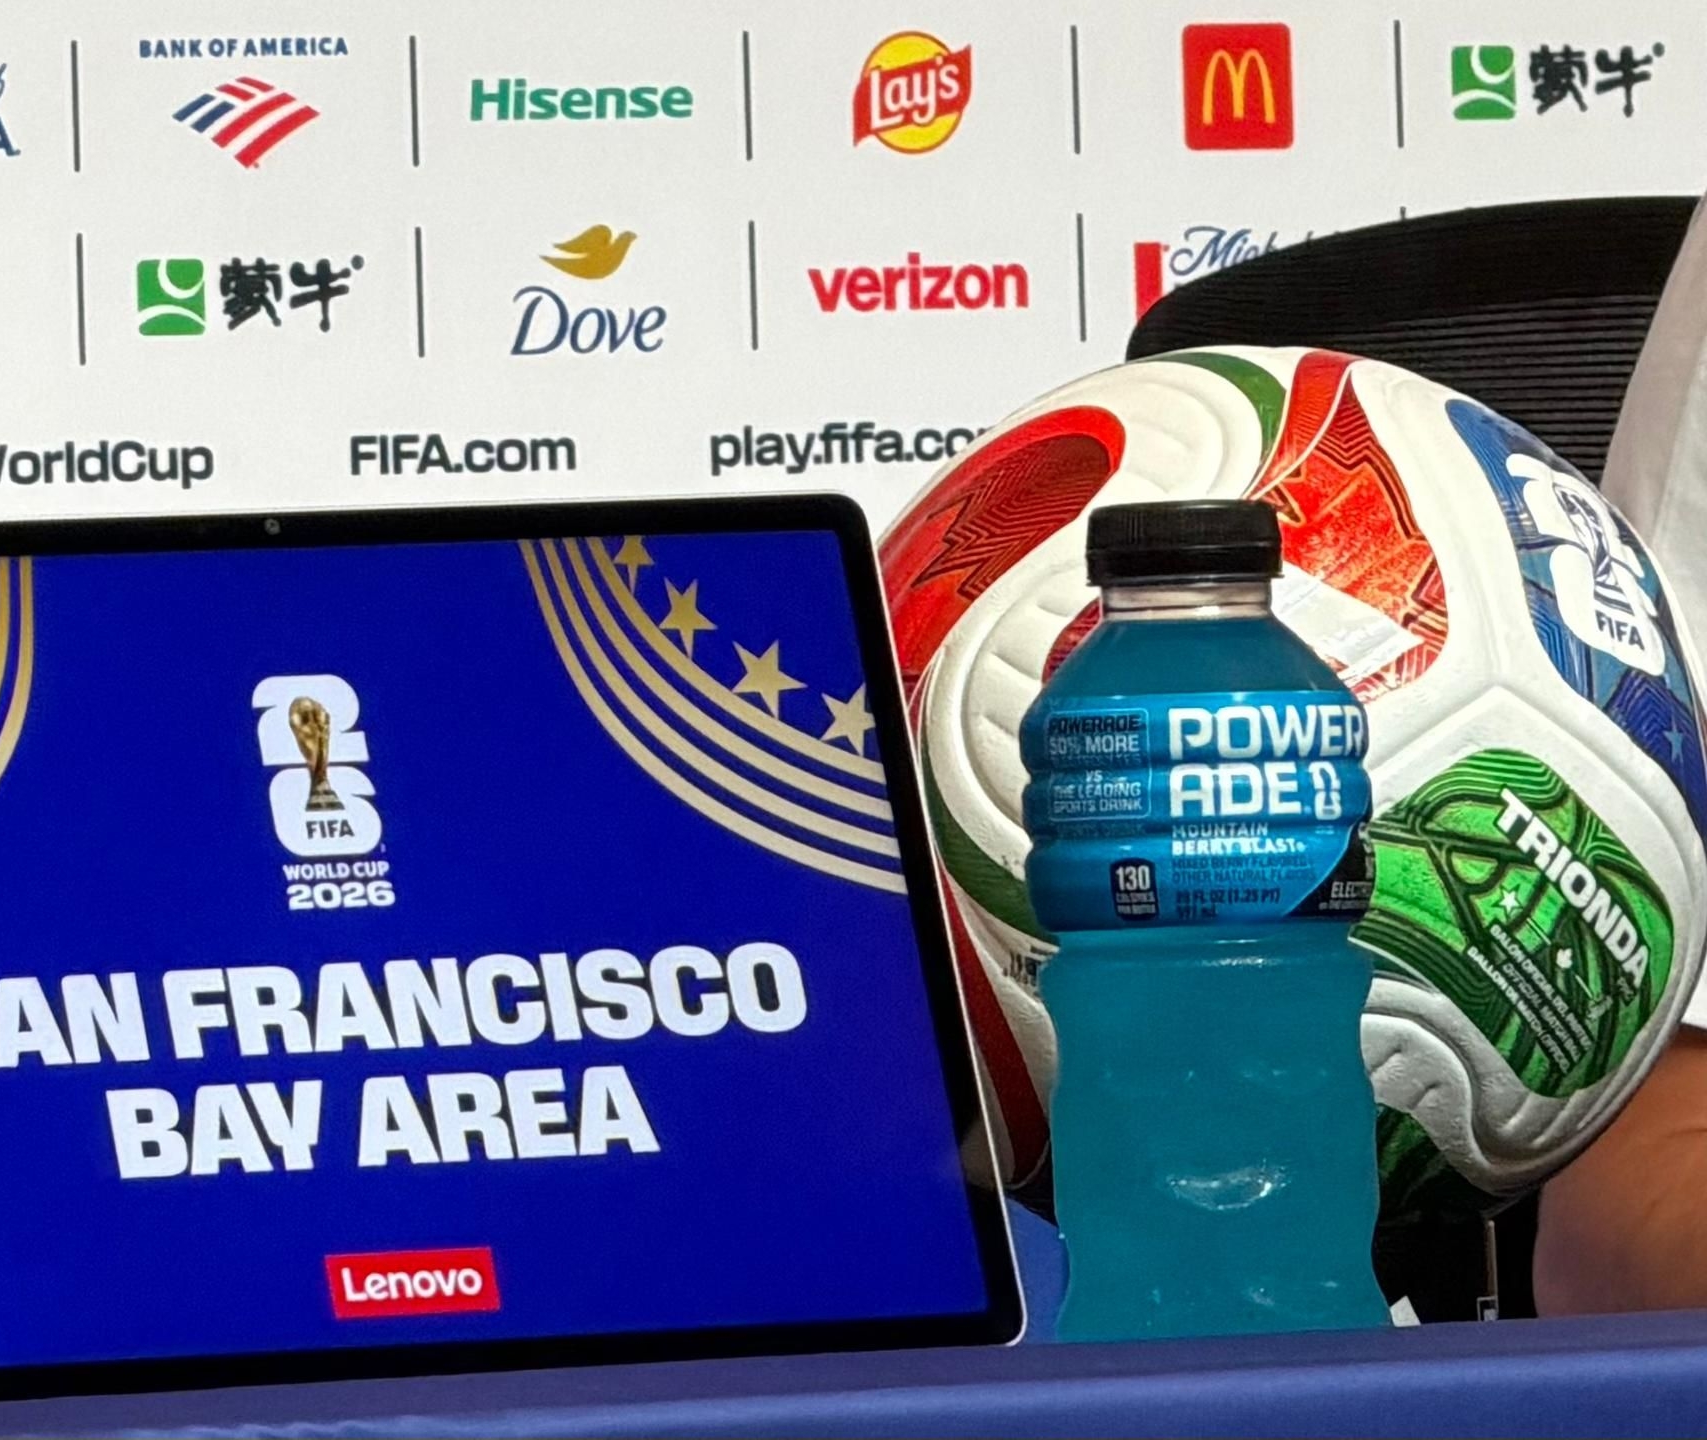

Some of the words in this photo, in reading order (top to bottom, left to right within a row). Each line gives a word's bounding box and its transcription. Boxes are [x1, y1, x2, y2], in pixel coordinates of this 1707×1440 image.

[140, 40, 202, 58] BANK
[208, 39, 237, 57] OF
[244, 38, 348, 56] AMERICA
[471, 79, 692, 121] Hisense
[869, 60, 960, 126] Lay's
[1529, 45, 1652, 117] 蒙牛
[220, 258, 351, 332] 蒙牛
[809, 253, 1028, 312] verizon
[511, 286, 666, 355] Dove
[351, 434, 576, 475] FIFA.com
[710, 421, 992, 476] play.fifa.co
[1595, 610, 1645, 650] FIFA
[1085, 734, 1139, 752] MORE
[1169, 705, 1364, 760] POWER
[1169, 762, 1302, 817] ADE
[306, 819, 355, 839] FIFA
[1172, 822, 1268, 839] MOUNTAIN
[1172, 839, 1237, 856] BERRY
[282, 862, 351, 881] WORLD
[352, 860, 390, 878] CUP
[1116, 865, 1150, 891] 130
[1493, 786, 1649, 990] TRIONDA
[286, 880, 396, 911] 2026
[163, 941, 809, 1060] FRANCISCO
[106, 1080, 323, 1179] BAY
[357, 1064, 661, 1169] AREA
[341, 1265, 484, 1306] Lenovo
